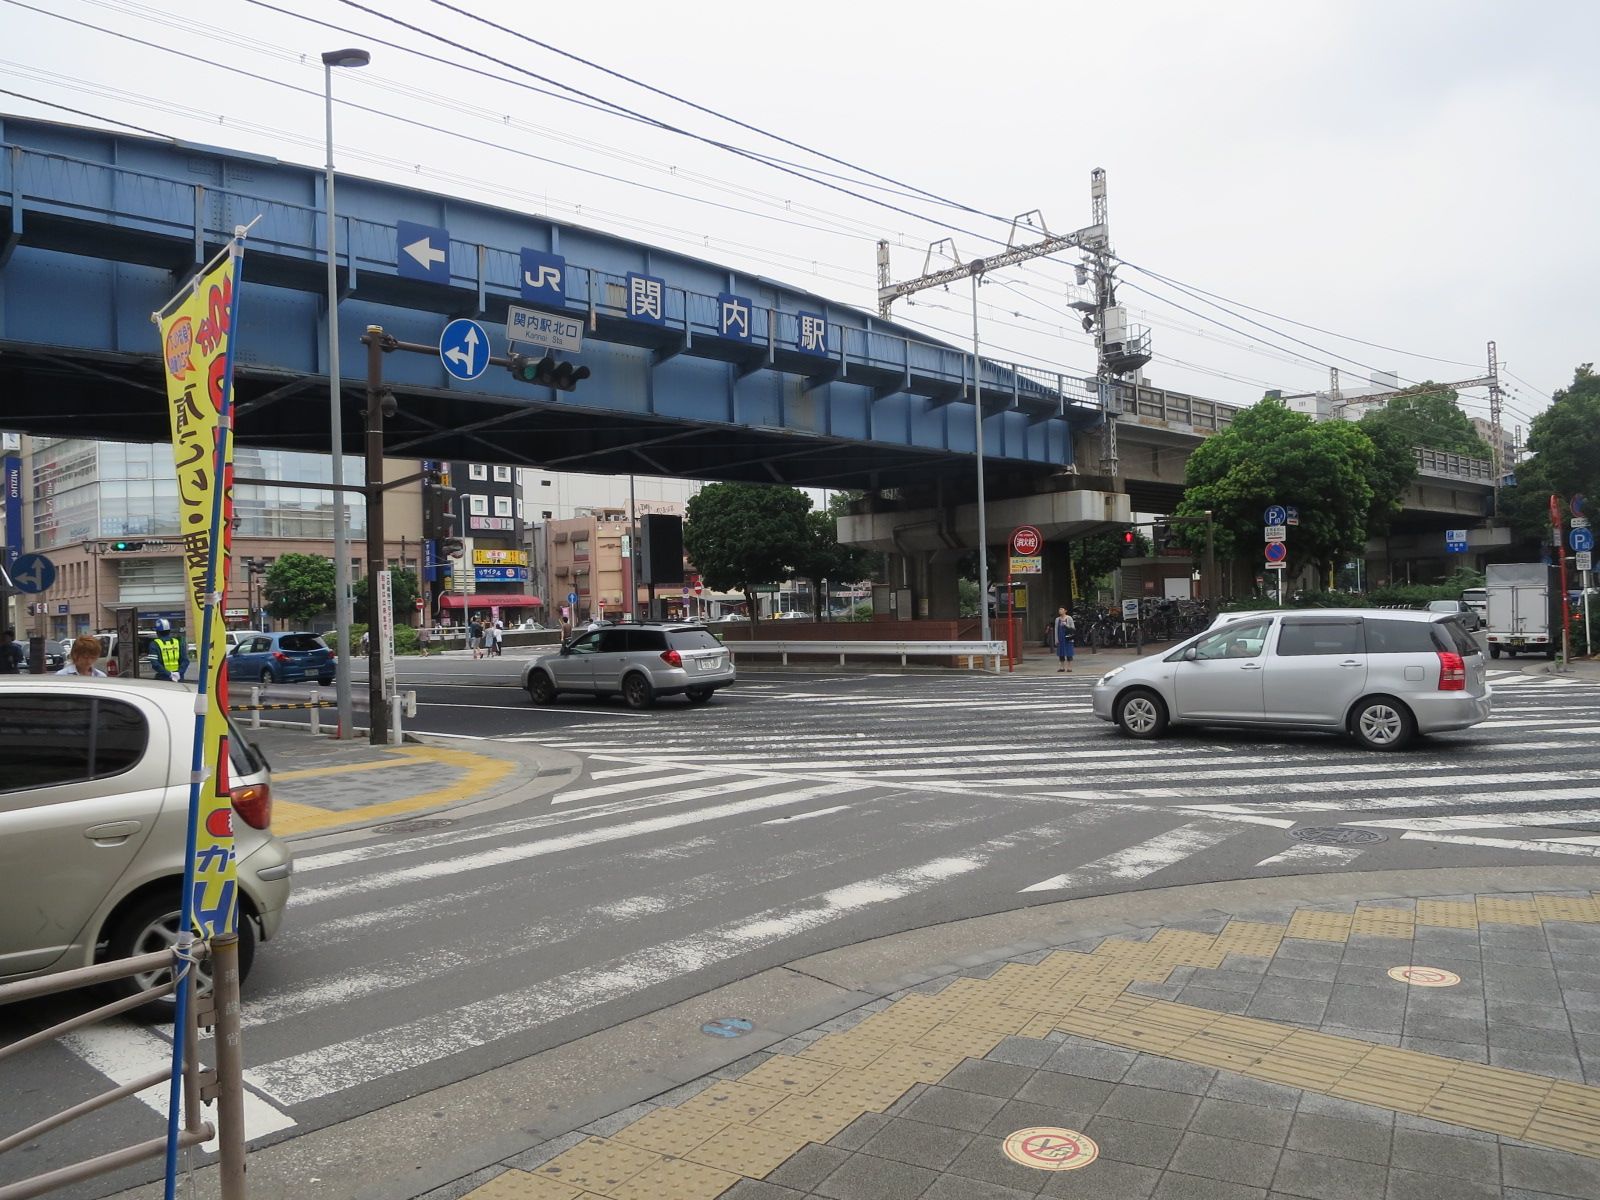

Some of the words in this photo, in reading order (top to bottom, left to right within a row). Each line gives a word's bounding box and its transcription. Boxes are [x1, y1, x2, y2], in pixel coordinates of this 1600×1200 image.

[524, 265, 561, 292] JR
[513, 312, 578, 338] 関内駅北口
[10, 469, 18, 498] MIZUHO
[1016, 537, 1036, 547] 消火栓
